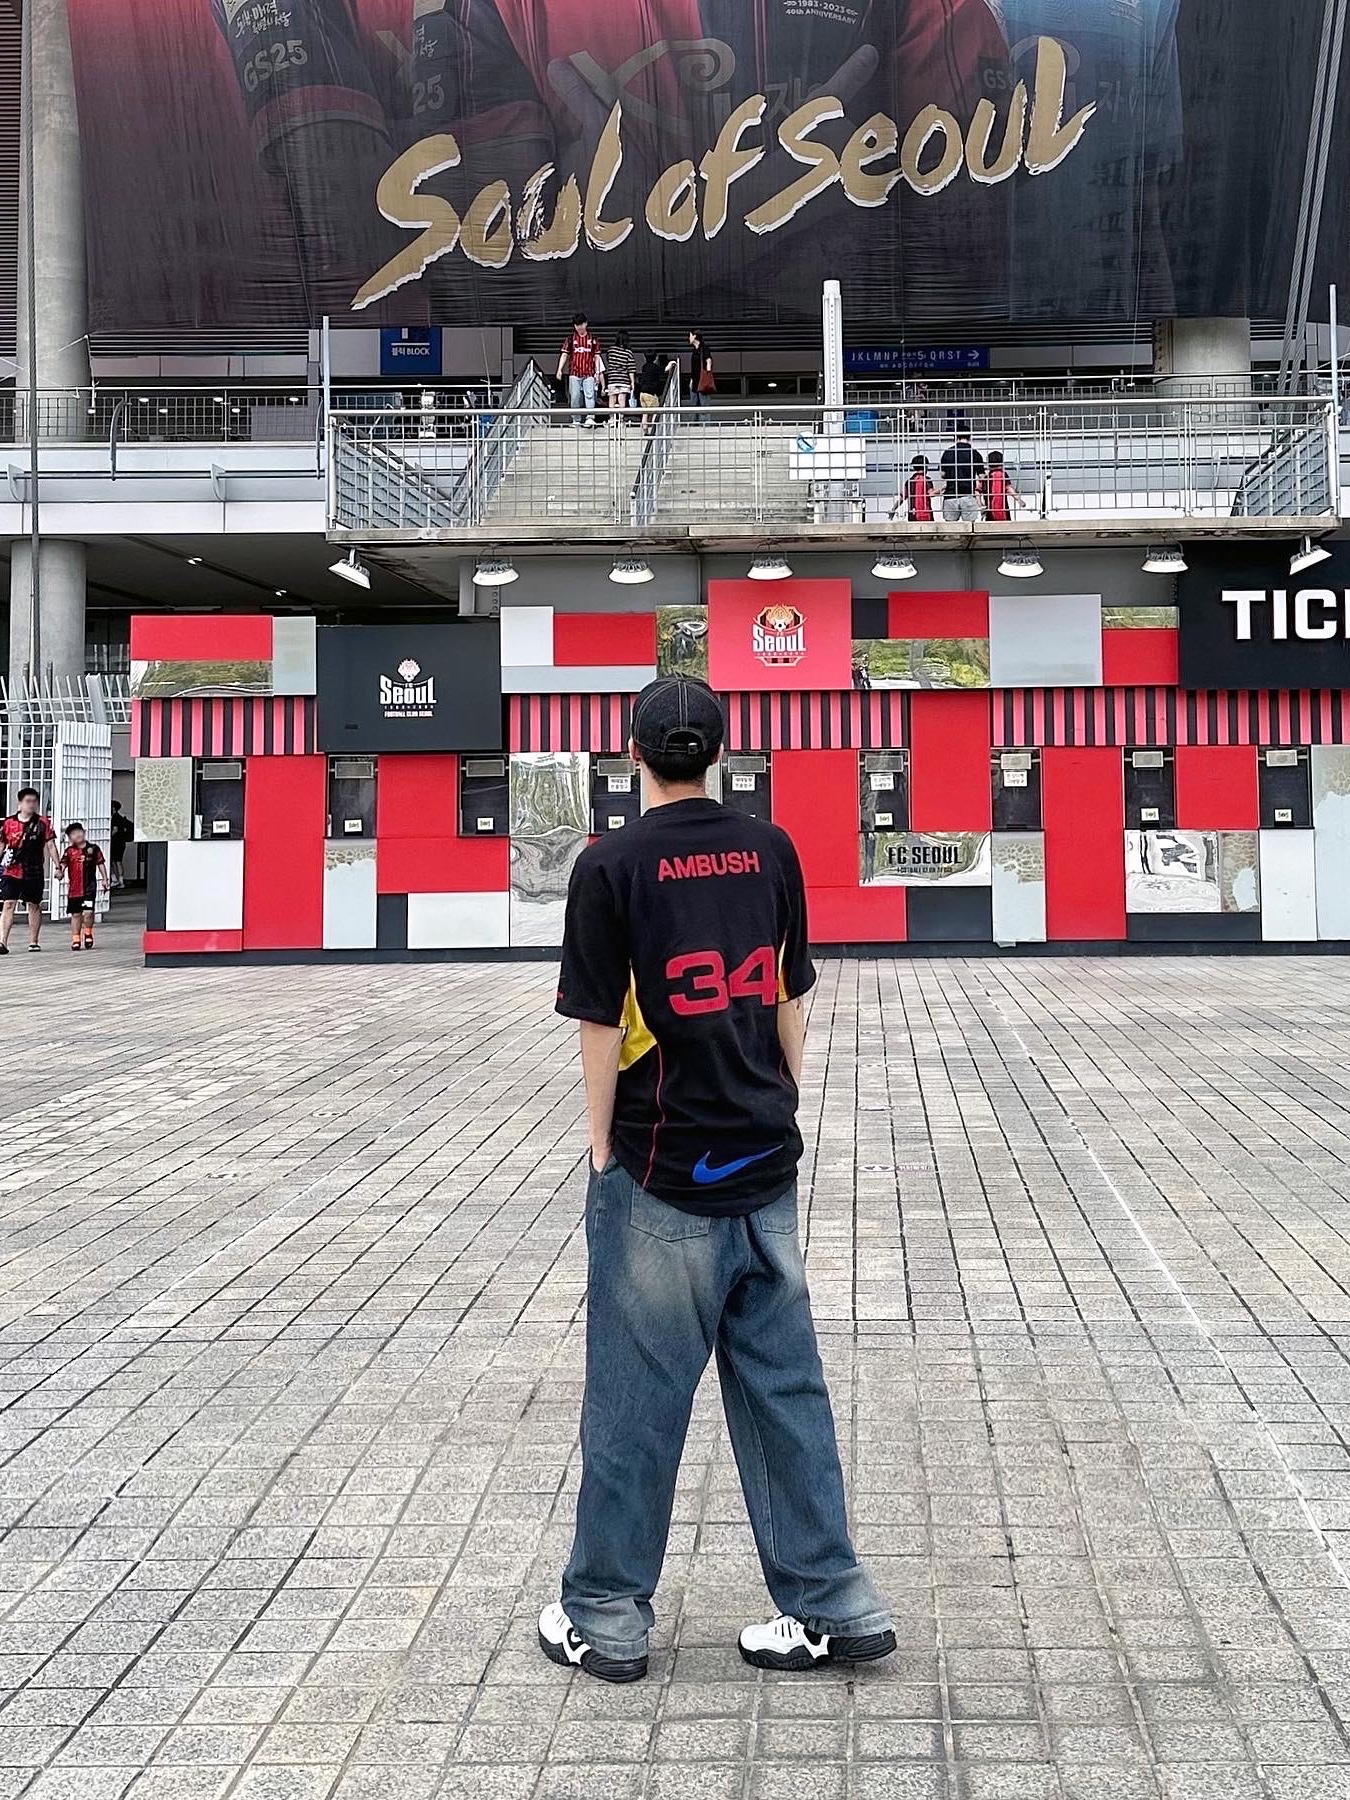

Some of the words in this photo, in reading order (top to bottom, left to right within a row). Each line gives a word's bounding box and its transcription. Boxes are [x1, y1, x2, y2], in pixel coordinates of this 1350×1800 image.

[805, 9, 857, 24] ANNIVERSARY
[244, 39, 308, 92] GS25
[351, 99, 634, 311] Soul
[645, 94, 767, 242] of
[406, 347, 430, 356] BLOCK
[1221, 589, 1350, 640] TIC
[752, 623, 807, 652] Seoul
[380, 674, 437, 705] Seoul
[657, 851, 761, 882] AMBUSH
[888, 846, 908, 865] FC
[911, 846, 963, 865] SEOUL
[665, 945, 779, 1016] 34
